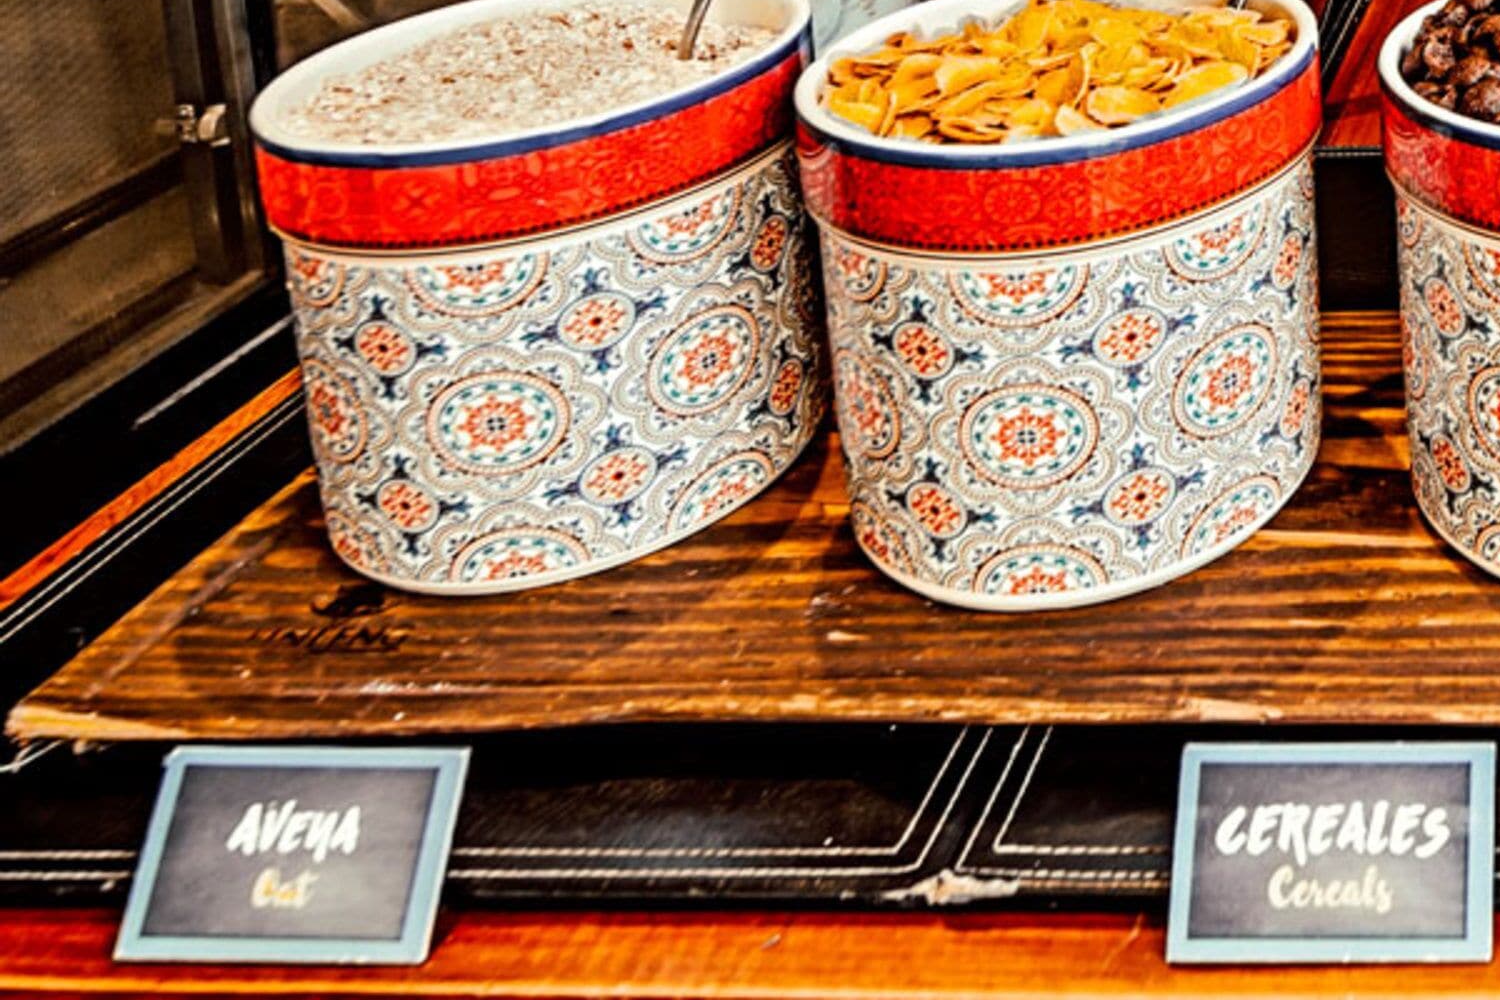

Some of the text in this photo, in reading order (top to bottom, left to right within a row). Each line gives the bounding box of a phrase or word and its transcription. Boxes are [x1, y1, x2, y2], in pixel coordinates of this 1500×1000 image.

[226, 799, 361, 862] AVENA
[1215, 800, 1450, 864] CEREALES
[1267, 864, 1393, 914] Cereals
